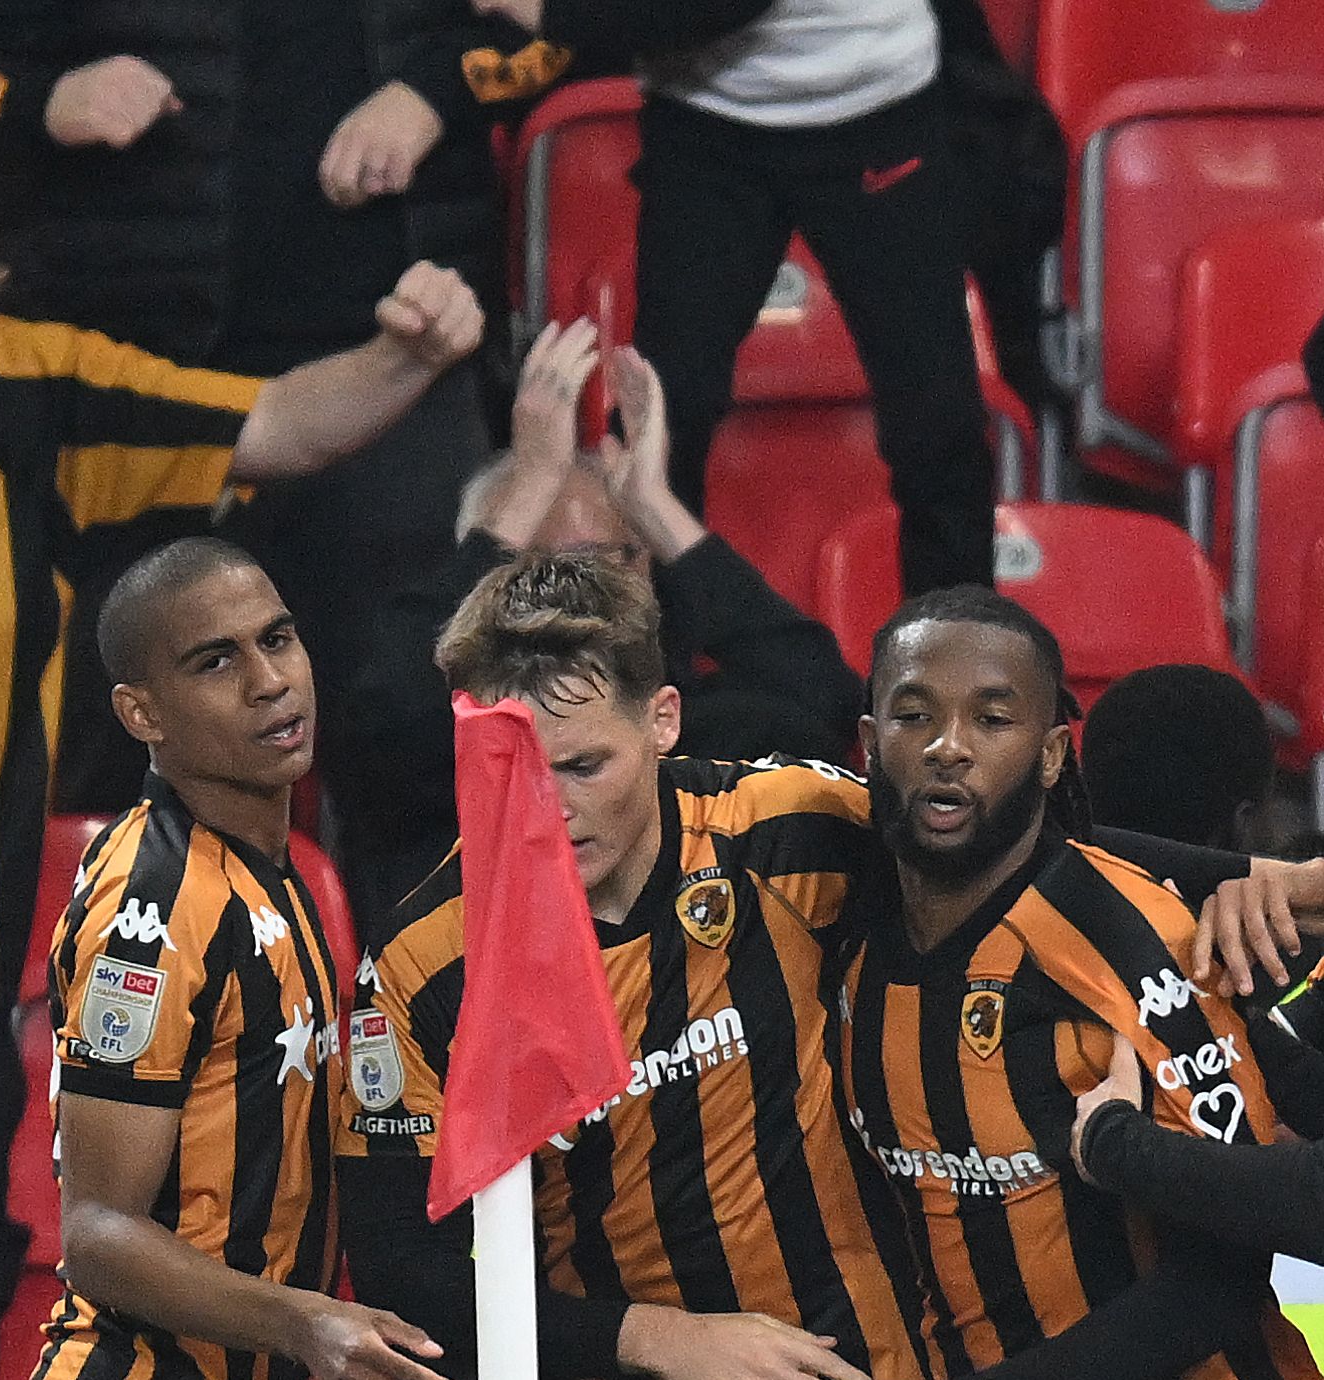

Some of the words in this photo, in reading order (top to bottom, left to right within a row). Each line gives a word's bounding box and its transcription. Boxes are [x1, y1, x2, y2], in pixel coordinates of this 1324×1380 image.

[96, 967, 122, 985] sky
[126, 973, 154, 991] bet
[100, 1036, 123, 1053] EFL
[1157, 1033, 1242, 1090] anex
[877, 1146, 1044, 1181] corendon
